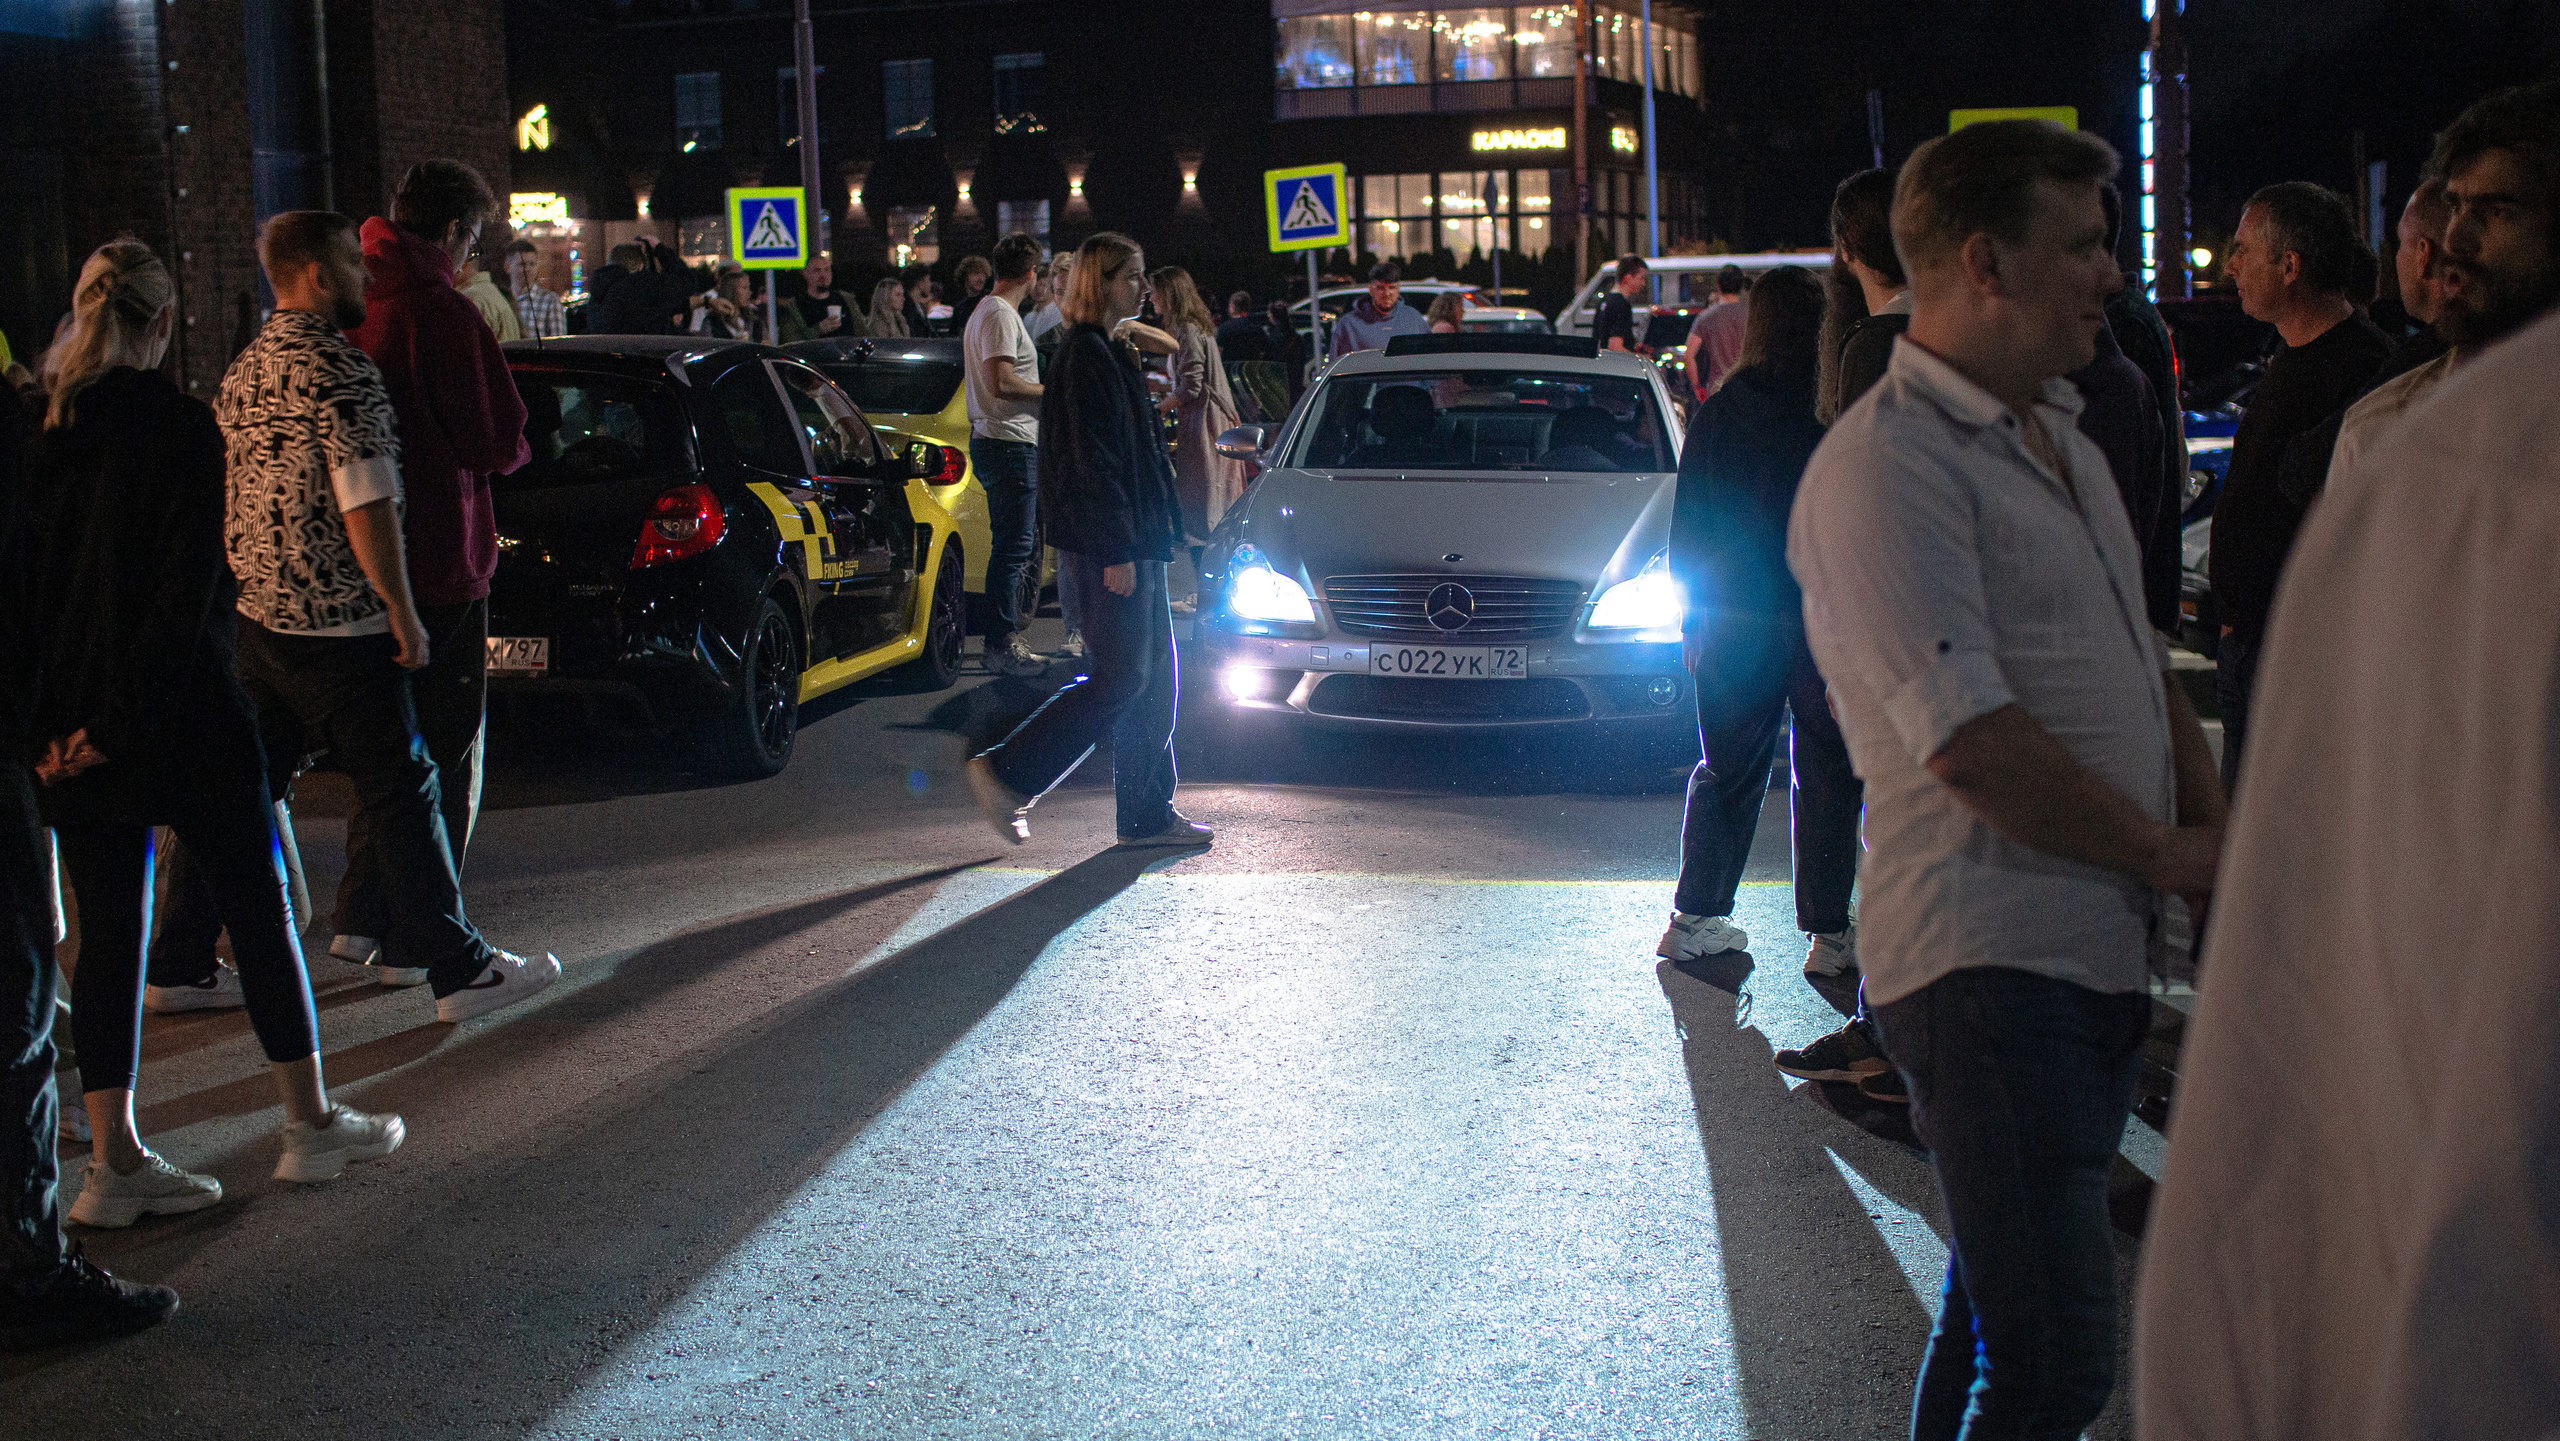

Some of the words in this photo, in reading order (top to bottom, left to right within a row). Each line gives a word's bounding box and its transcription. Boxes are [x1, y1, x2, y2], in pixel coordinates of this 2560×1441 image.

[1473, 127, 1567, 150] КАРАОКЕ
[504, 639, 542, 659] 797
[1494, 649, 1519, 669] 72
[511, 659, 531, 667] RUS
[1490, 668, 1509, 676] RUS
